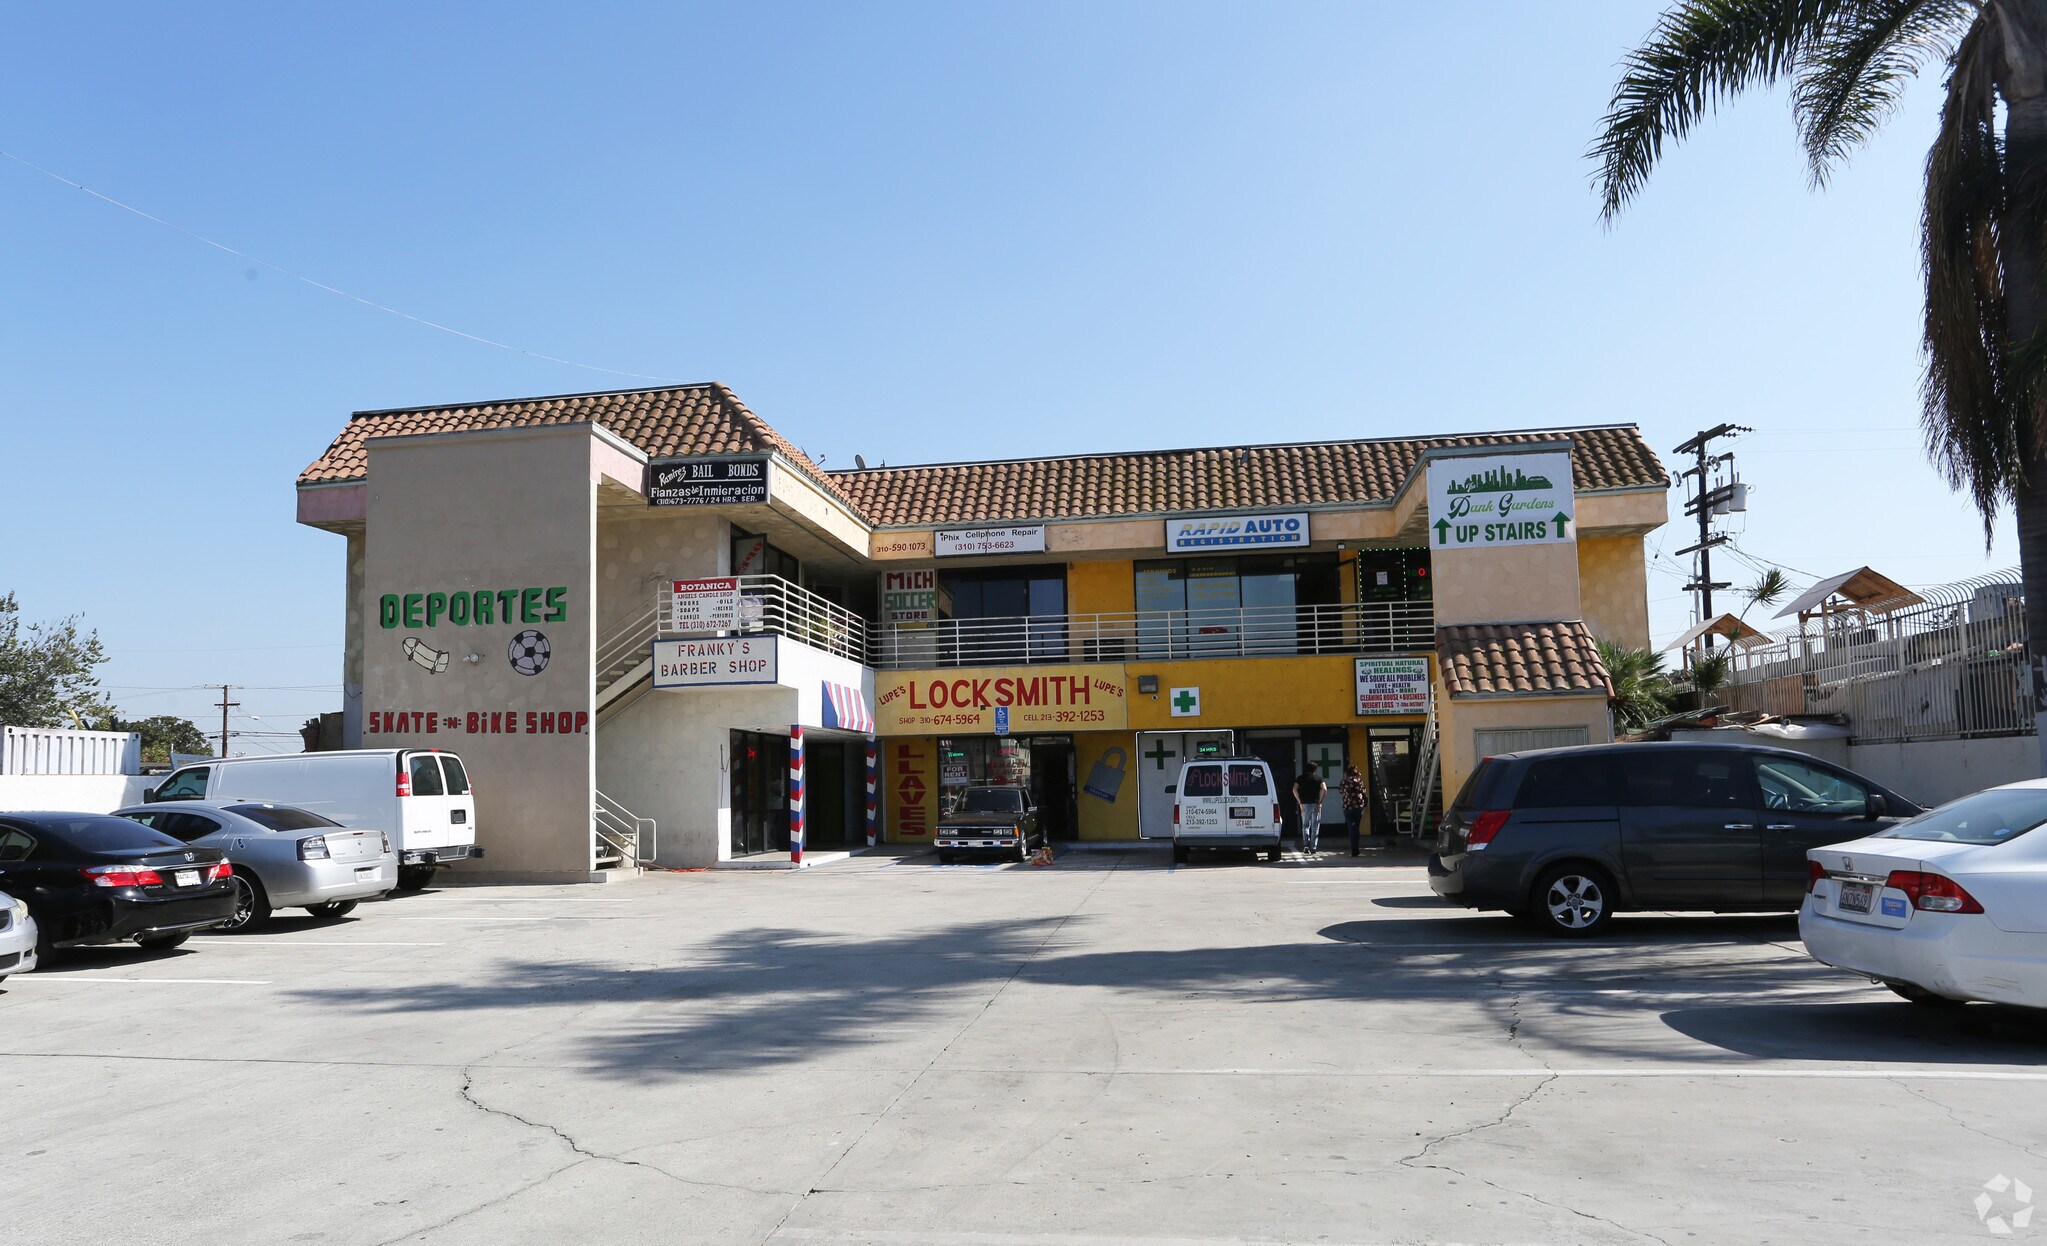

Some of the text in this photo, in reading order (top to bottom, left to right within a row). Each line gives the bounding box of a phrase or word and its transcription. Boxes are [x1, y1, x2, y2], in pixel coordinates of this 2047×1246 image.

[658, 463, 759, 487] Ramirez BAIL BONDS
[651, 487, 691, 498] Fianzas
[1447, 493, 1554, 520] Dank Gardens
[965, 530, 1006, 539] Cellphone
[1012, 528, 1038, 537] Repair
[1179, 518, 1300, 537] RAPID AUTO
[1456, 521, 1546, 543] UP STAIRS
[955, 541, 1015, 551] (310) 753-6623
[1179, 534, 1298, 546] REGISTRATION
[680, 582, 731, 591] BOTANICA
[380, 586, 568, 630] DEPORTES
[884, 592, 936, 610] SOCCER
[891, 611, 928, 620] STORE
[679, 621, 689, 629] TEL
[691, 620, 705, 629] (310)
[678, 640, 750, 657] FRANKY'S
[661, 659, 767, 677] BARBER SHOP
[1360, 675, 1368, 683] WE
[1387, 674, 1396, 682] ALL
[1397, 673, 1425, 682] PROBLEMS
[878, 675, 1125, 709] LUPE'S LOCKSMITH LUPE'S
[369, 712, 438, 734] SKATE
[899, 710, 1105, 726] SHOP 310-674-5964 CELL 213-392-1253
[1200, 772, 1249, 787] LOCKSMITH
[898, 745, 927, 836] LLAVES
